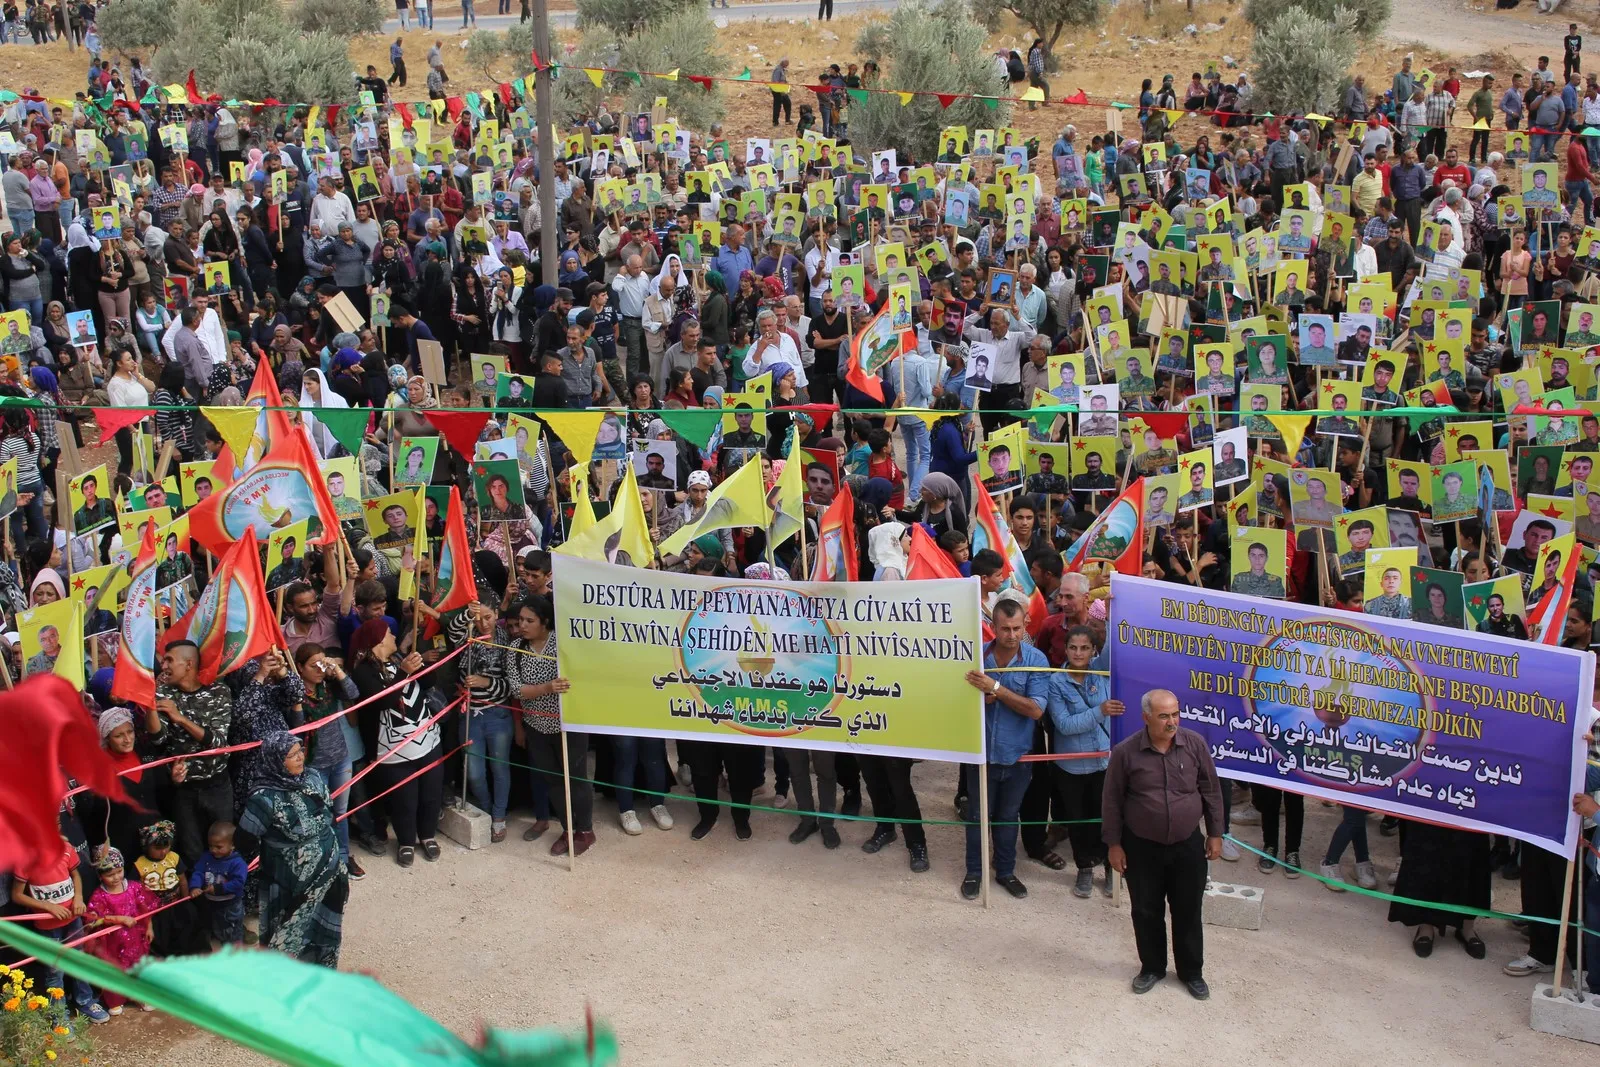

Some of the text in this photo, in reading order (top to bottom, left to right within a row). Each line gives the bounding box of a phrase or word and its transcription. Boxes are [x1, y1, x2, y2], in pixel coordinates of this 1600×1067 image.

[582, 581, 665, 609] DESTÛRA
[670, 588, 698, 611] ME
[703, 590, 792, 617] PEYMANA
[797, 596, 849, 621] MEYA
[927, 602, 953, 624] YE
[569, 617, 595, 640] KU
[620, 619, 682, 648] XWÎNA
[687, 624, 767, 654] ŞEHÎDÊN
[772, 632, 800, 654] ME
[803, 631, 851, 656] HATÎ
[1161, 598, 1185, 620] EM
[1281, 618, 1387, 656] KOALÎSYONA
[1391, 637, 1520, 678] NAVNETEWEYÎ
[652, 668, 902, 700] دستورنا هو عقدنا الاجتماعي
[1118, 620, 1131, 644] Û
[1132, 626, 1228, 661] NETEWEYÊN
[1230, 642, 1302, 673] YEKBÛYÎ
[1304, 654, 1327, 677] YA
[1349, 661, 1420, 694] HEMBER
[1423, 675, 1446, 698] NE
[1450, 680, 1567, 724] BEŞDARBÛNA
[1189, 670, 1213, 692] ME
[1237, 678, 1311, 710] DESTÛRÊ
[1313, 690, 1336, 713] DE
[1339, 694, 1428, 730] ŞERMEZAR
[669, 698, 888, 736] الذي كتب بدماء شهدائنا
[1179, 703, 1523, 786] ندين صمت التحالف الدولي والامم المتحد
[1210, 738, 1477, 811] تجاه عدم مشاركتنا في الدستور
